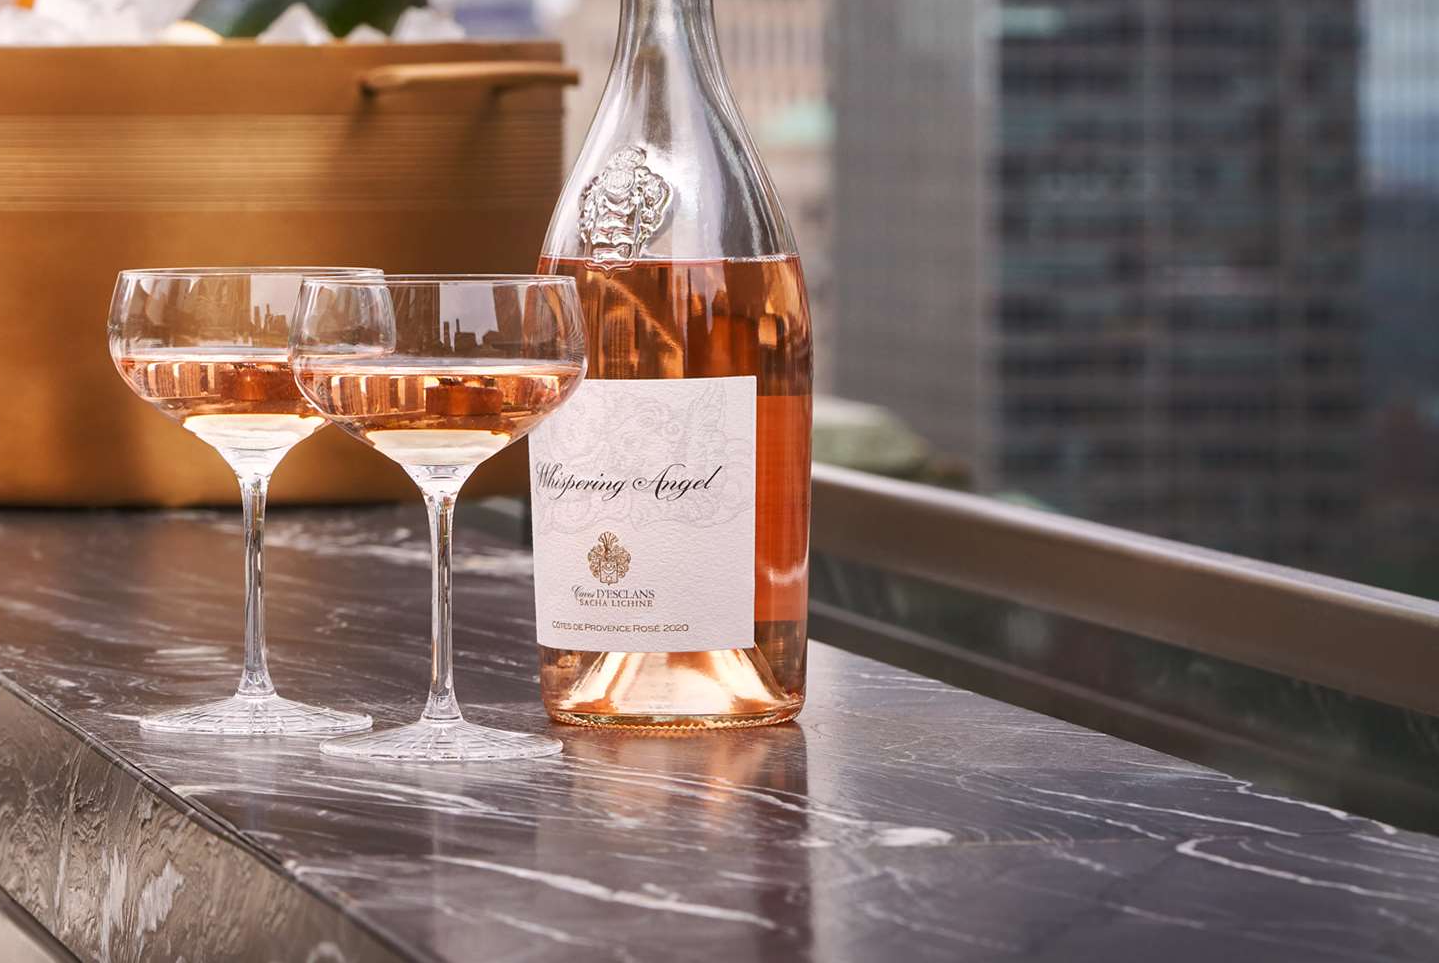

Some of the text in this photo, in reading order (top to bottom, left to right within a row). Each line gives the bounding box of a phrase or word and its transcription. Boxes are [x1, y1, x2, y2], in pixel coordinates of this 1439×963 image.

[536, 462, 722, 501] Whispering Angel
[596, 589, 655, 598] D'ESCLANS
[580, 599, 653, 607] SACHA LICHINE
[572, 623, 583, 631] DE
[584, 623, 631, 632] PROVENCE
[663, 623, 689, 632] 2020
